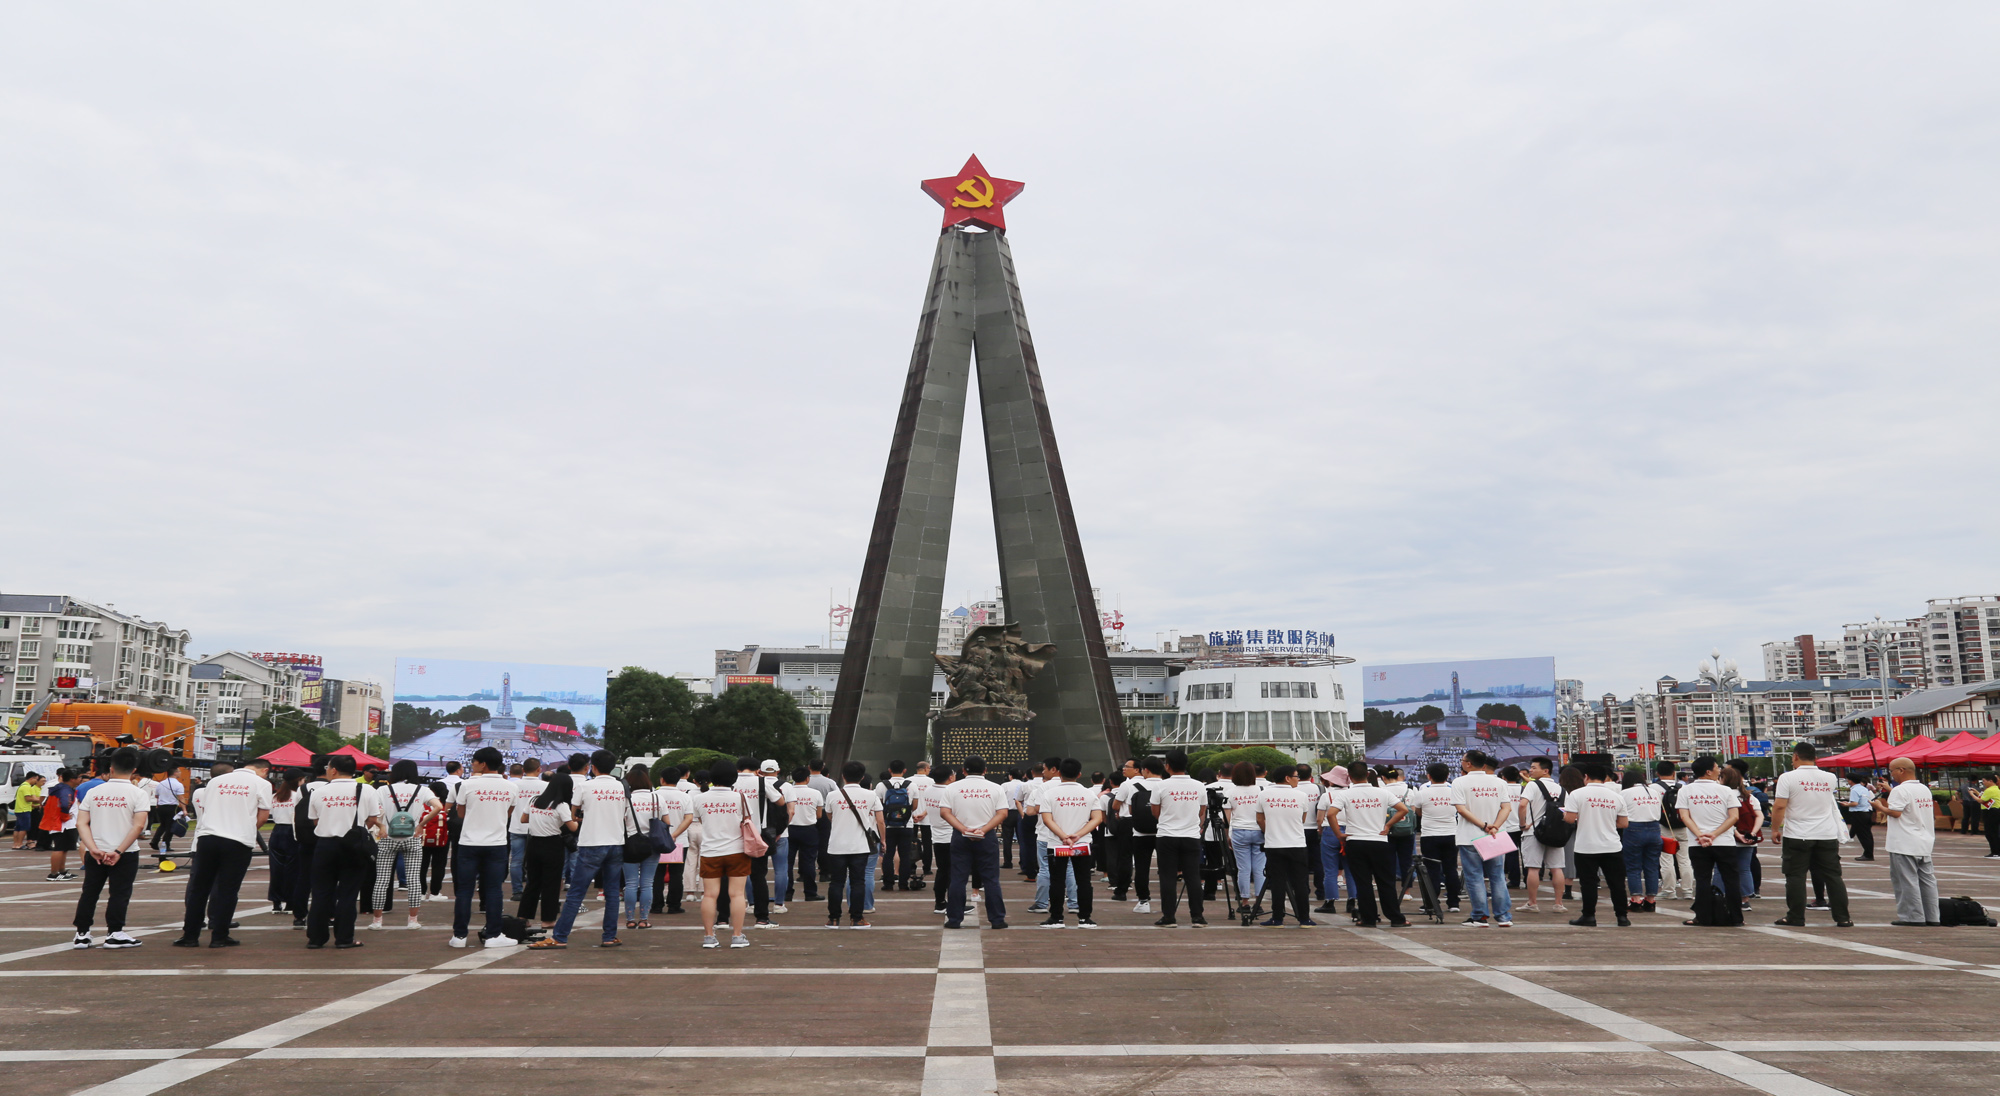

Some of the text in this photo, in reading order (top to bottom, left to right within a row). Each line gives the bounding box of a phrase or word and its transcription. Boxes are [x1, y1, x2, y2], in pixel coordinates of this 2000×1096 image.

[1101, 609, 1124, 630] 站
[1209, 629, 1335, 648] 旅游集散服务中心
[408, 664, 427, 675] 于都
[1371, 671, 1387, 682] 于都
